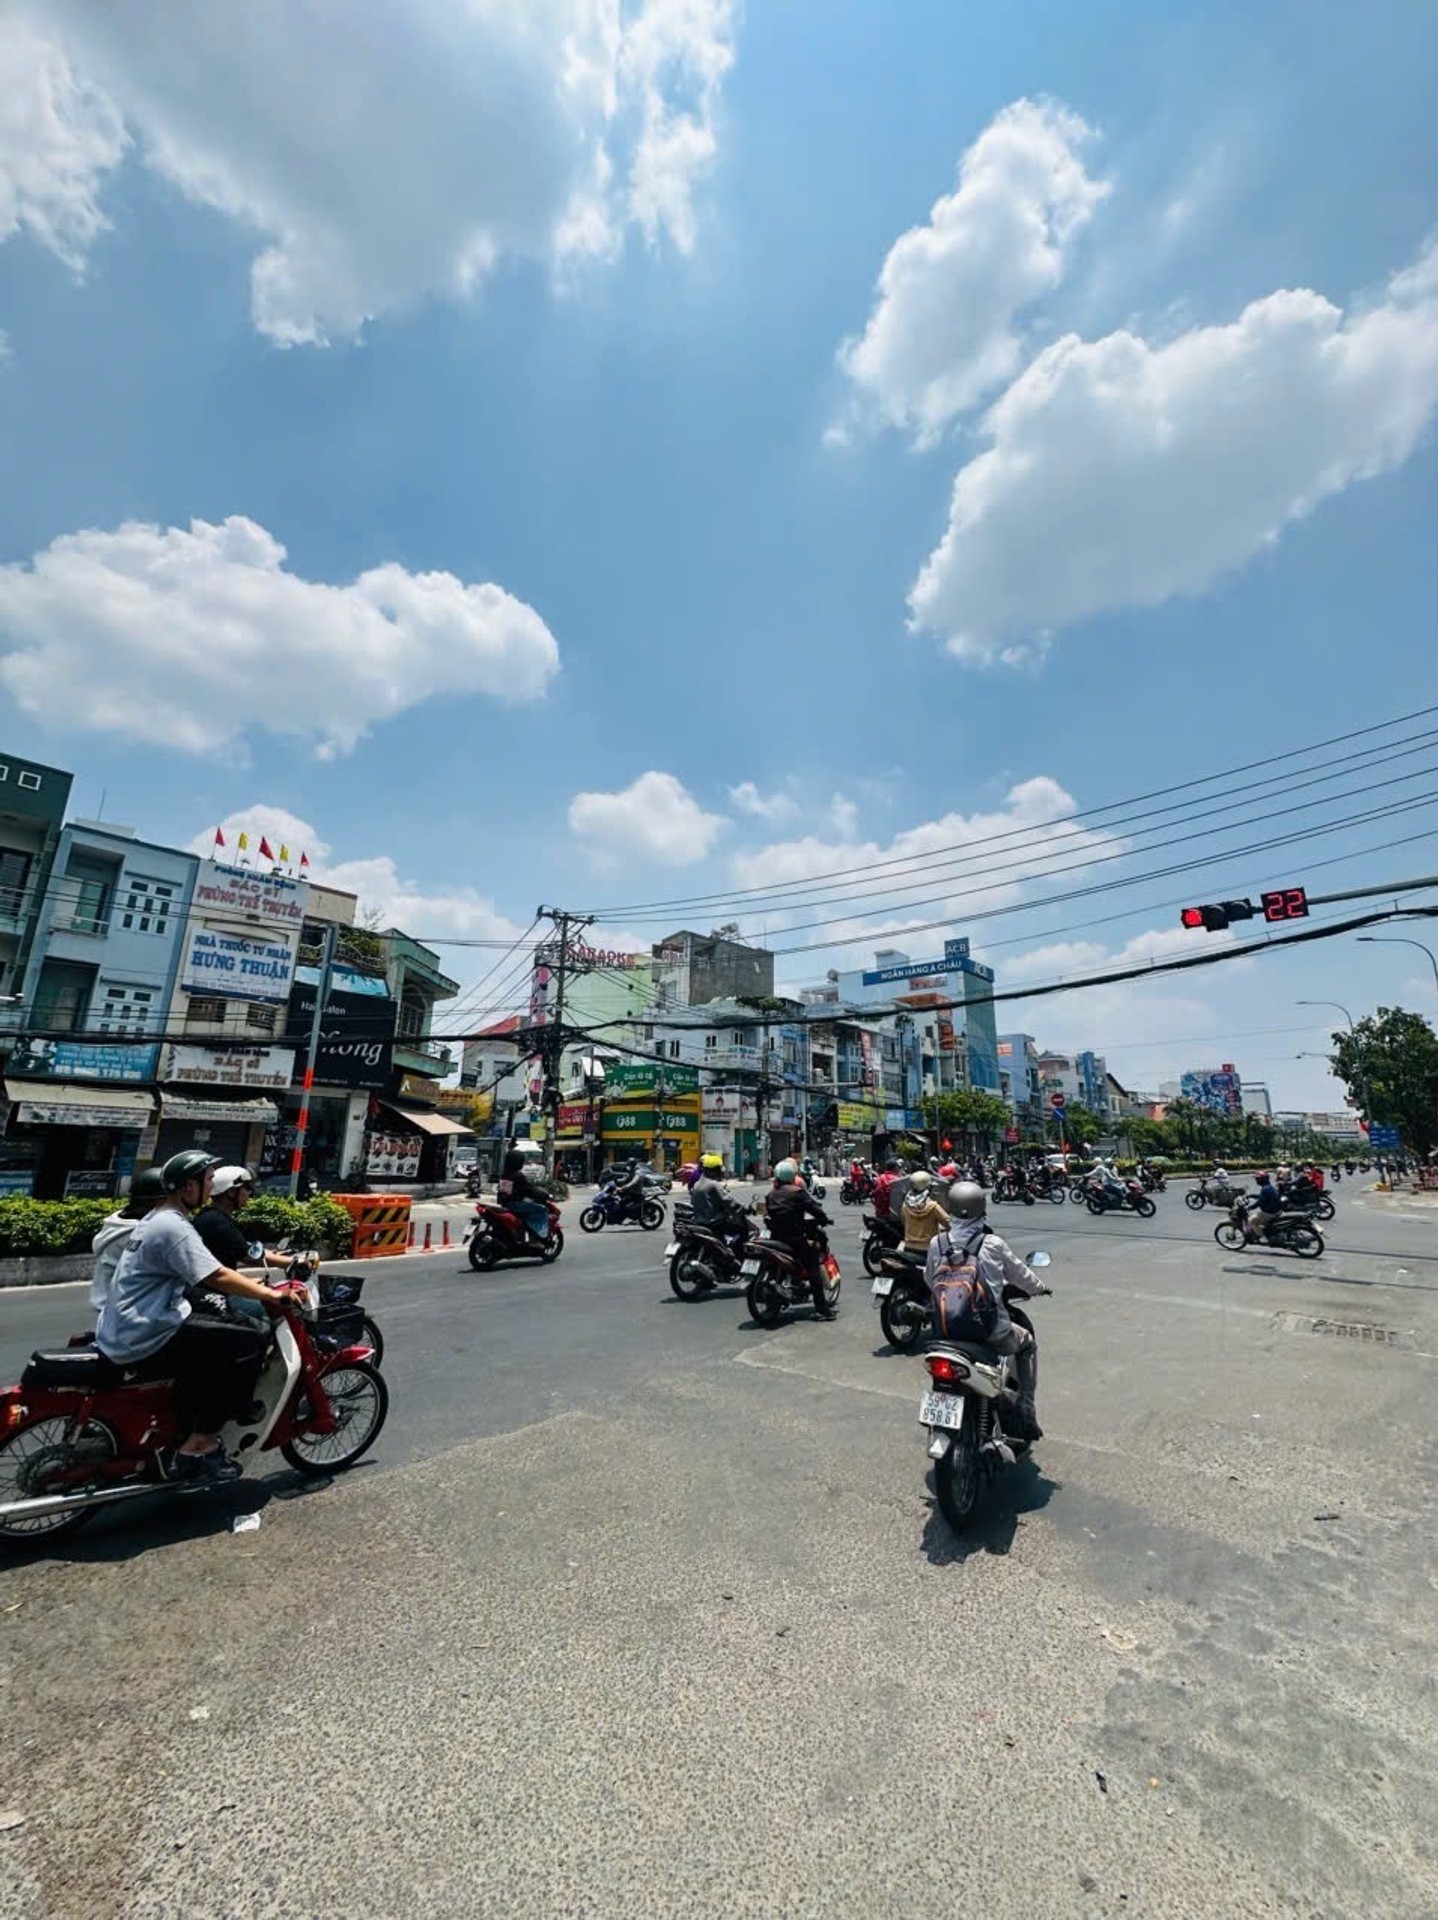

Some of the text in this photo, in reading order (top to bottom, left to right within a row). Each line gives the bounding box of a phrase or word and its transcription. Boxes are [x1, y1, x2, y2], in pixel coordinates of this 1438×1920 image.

[1267, 891, 1304, 919] 22
[194, 934, 217, 948] NHÀ
[220, 938, 251, 953] THUỐC
[266, 947, 292, 960] NHÂN
[946, 943, 967, 954] ACB
[191, 950, 290, 980] HƯNG THUẬN
[881, 969, 904, 980] NGÂN
[905, 964, 928, 976] HÀNG
[937, 960, 962, 970] CHÂU
